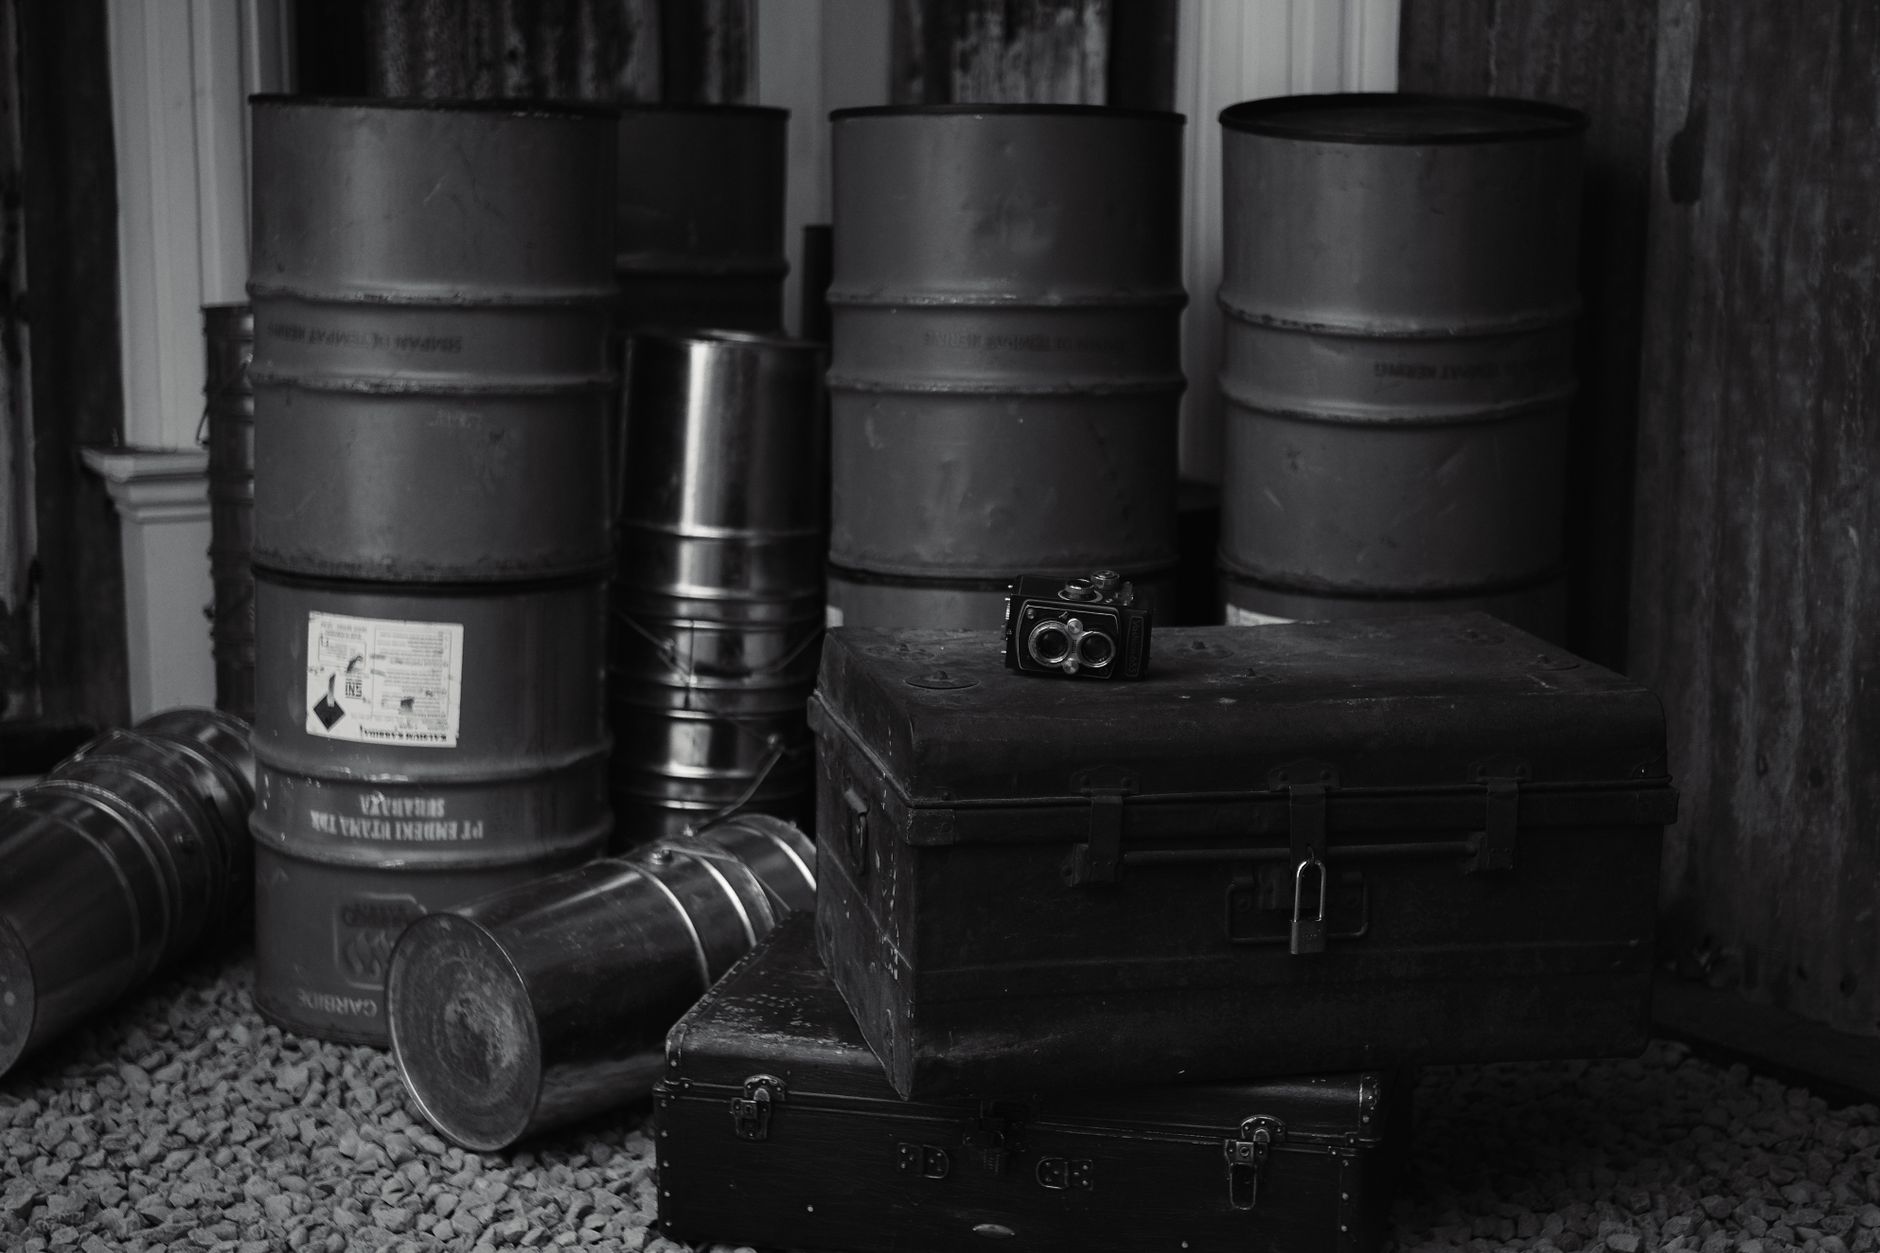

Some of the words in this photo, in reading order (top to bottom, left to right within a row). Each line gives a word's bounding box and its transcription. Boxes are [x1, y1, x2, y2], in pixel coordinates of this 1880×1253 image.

[359, 795, 446, 819] SURABAYA
[338, 815, 392, 841] UTAMA
[394, 821, 459, 841] EMDEKI
[461, 820, 484, 840] PT
[296, 988, 378, 1018] CARBIDE
